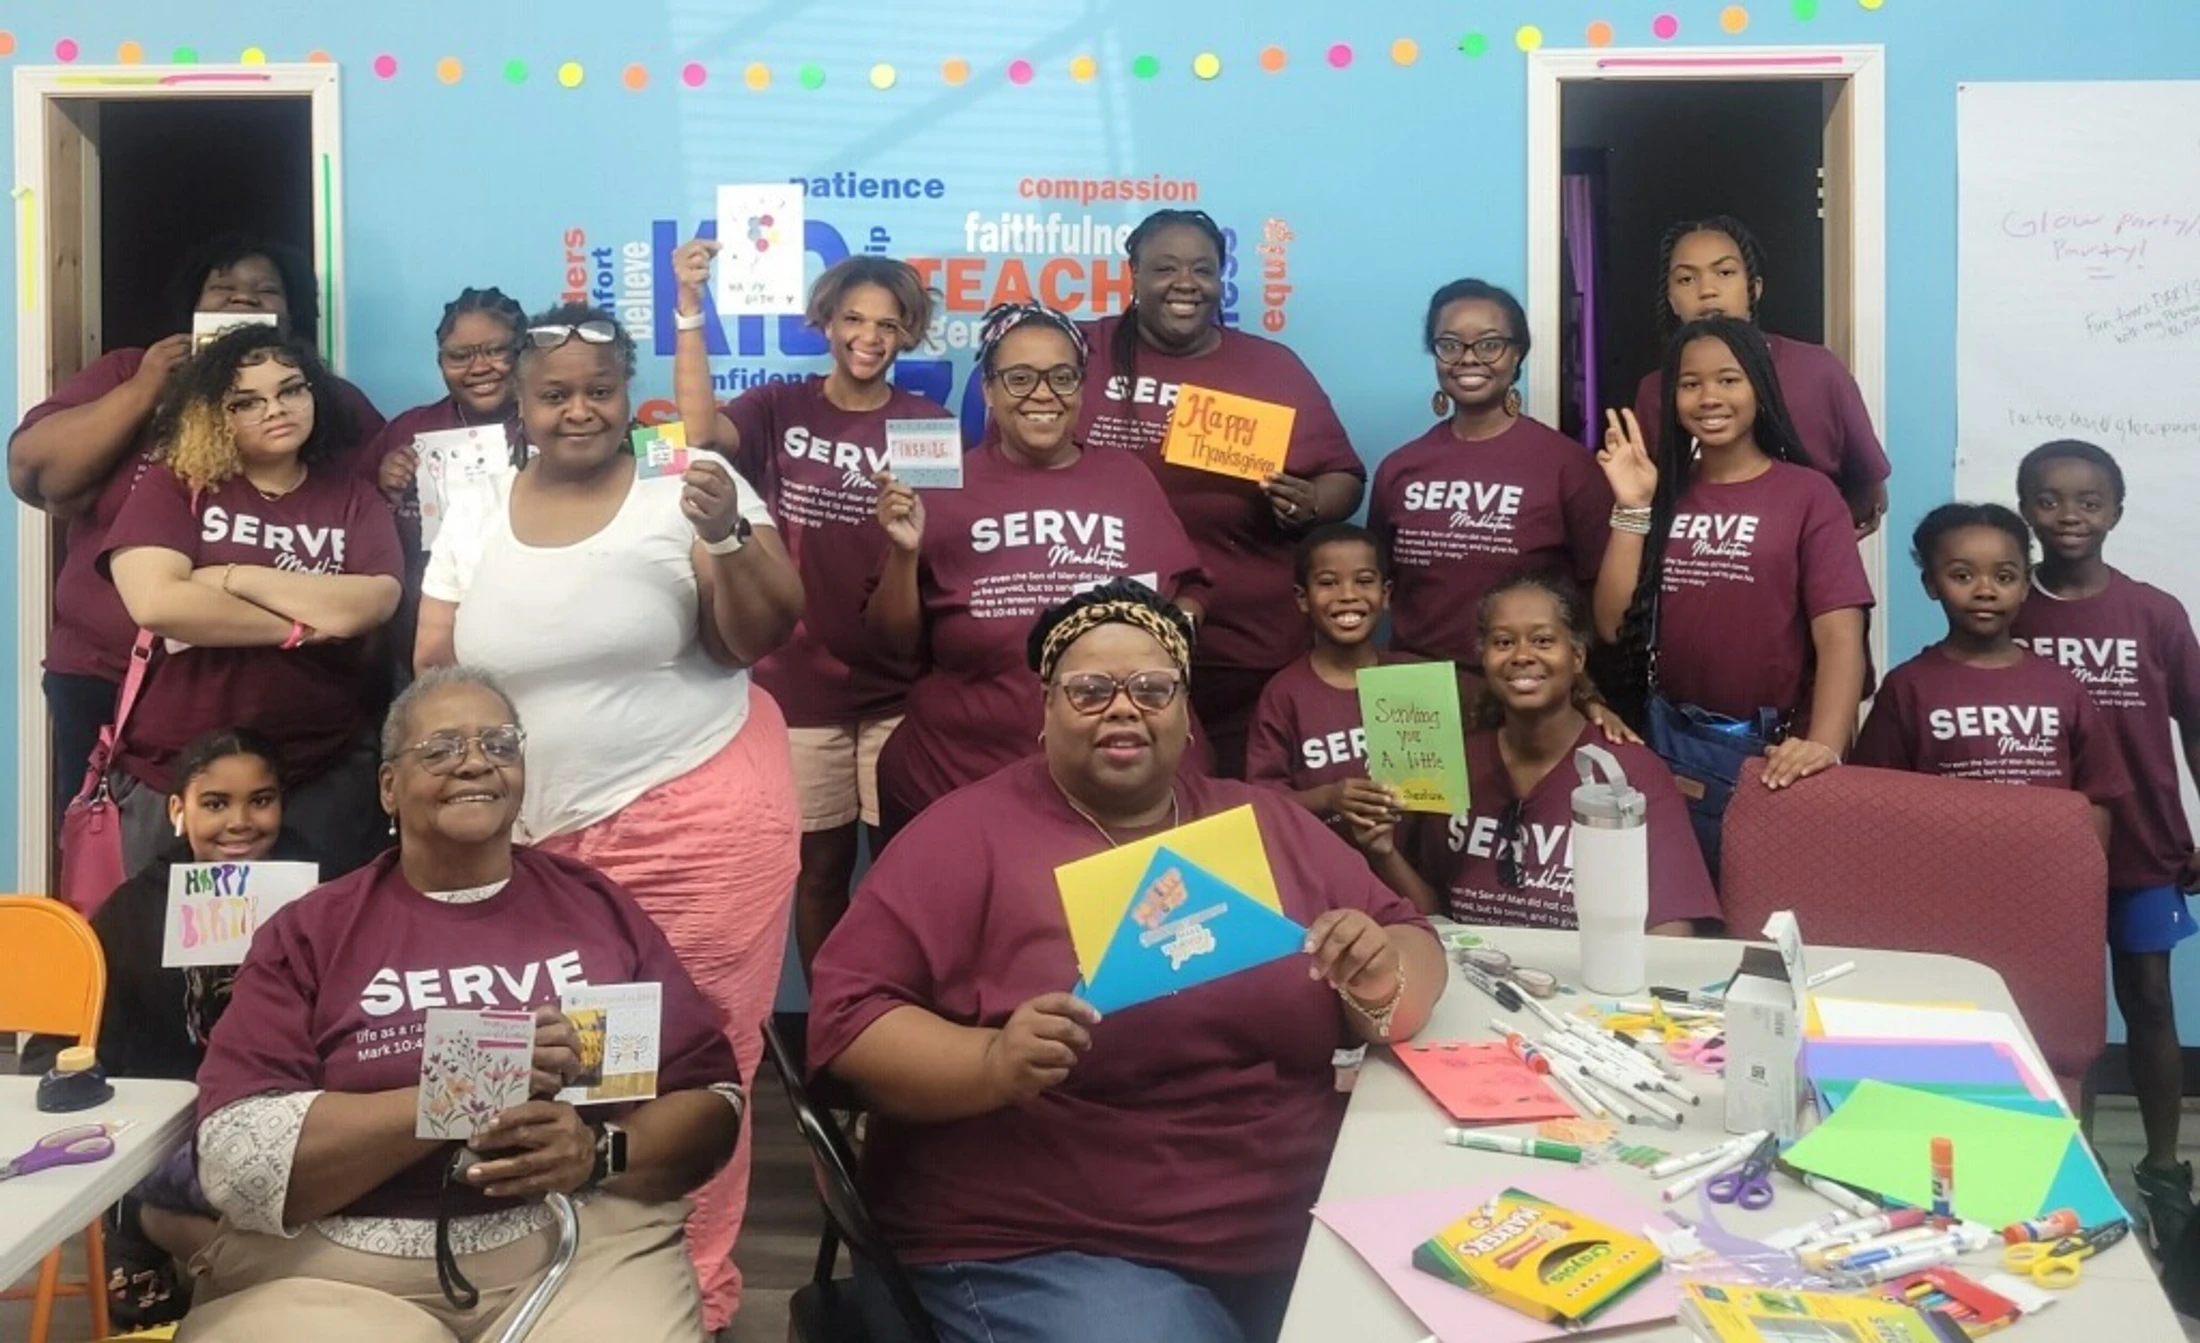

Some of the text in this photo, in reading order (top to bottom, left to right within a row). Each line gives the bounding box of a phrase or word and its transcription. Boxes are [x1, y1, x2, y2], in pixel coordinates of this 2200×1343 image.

[1019, 175, 1197, 205] compassion
[964, 211, 1132, 254] faithfulne
[561, 227, 589, 305] ders
[1104, 376, 1181, 407] SER
[1178, 394, 1258, 446] Happy
[783, 426, 893, 474] SERV
[1403, 480, 1525, 515] SERVE
[201, 505, 346, 563] SERVE
[971, 509, 1127, 553] SERVE
[1668, 513, 1760, 542] ERVE
[2012, 637, 2139, 669] ERVE
[1929, 705, 2060, 740] SERVE
[1302, 727, 1370, 769] SER
[1382, 750, 1394, 768] A
[186, 864, 250, 896] HAPPY
[360, 950, 588, 1017] SERVE
[394, 1038, 423, 1054] 10:4
